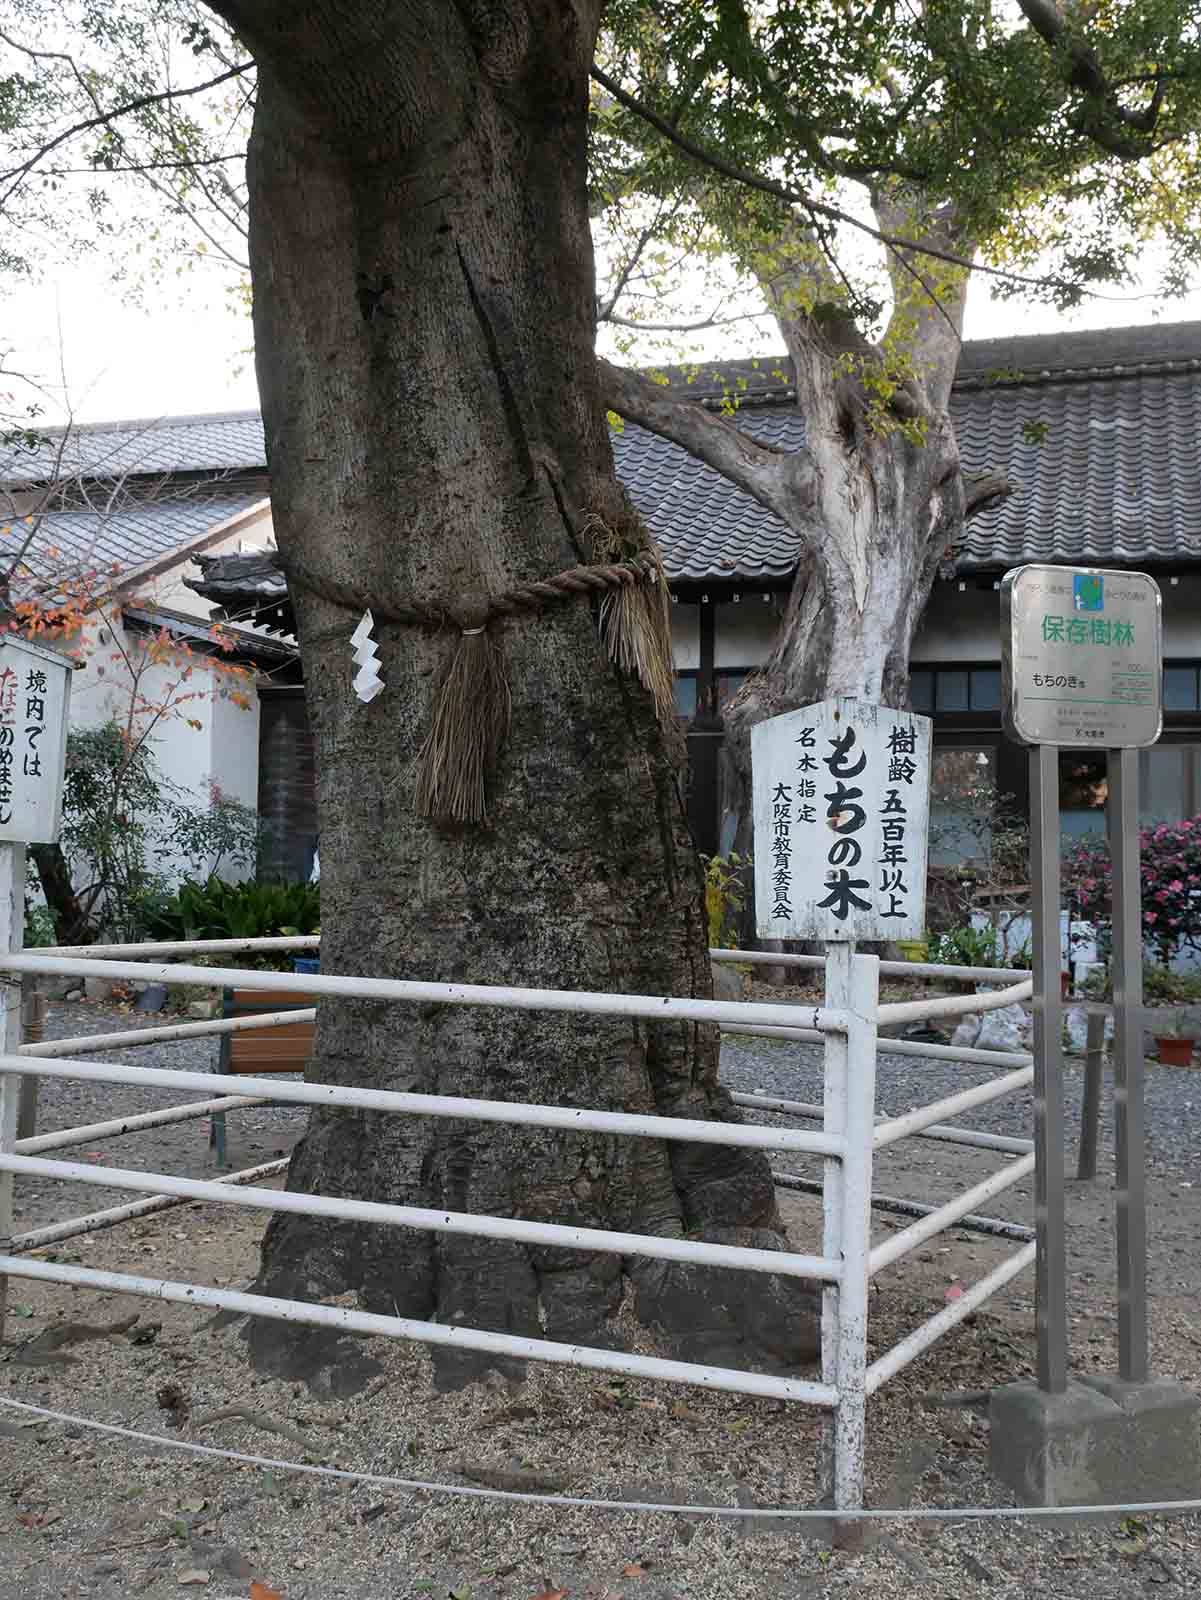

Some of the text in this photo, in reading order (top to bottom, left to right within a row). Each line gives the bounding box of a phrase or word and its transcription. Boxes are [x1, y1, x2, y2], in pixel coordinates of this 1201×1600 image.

[1032, 673, 1079, 688] もちのき
[1041, 615, 1135, 646] 保存樹林
[24, 669, 47, 777] 境内では
[795, 726, 819, 824] 名木指定
[816, 725, 872, 920] もちの木
[771, 782, 793, 921] 大阪市教育委員会
